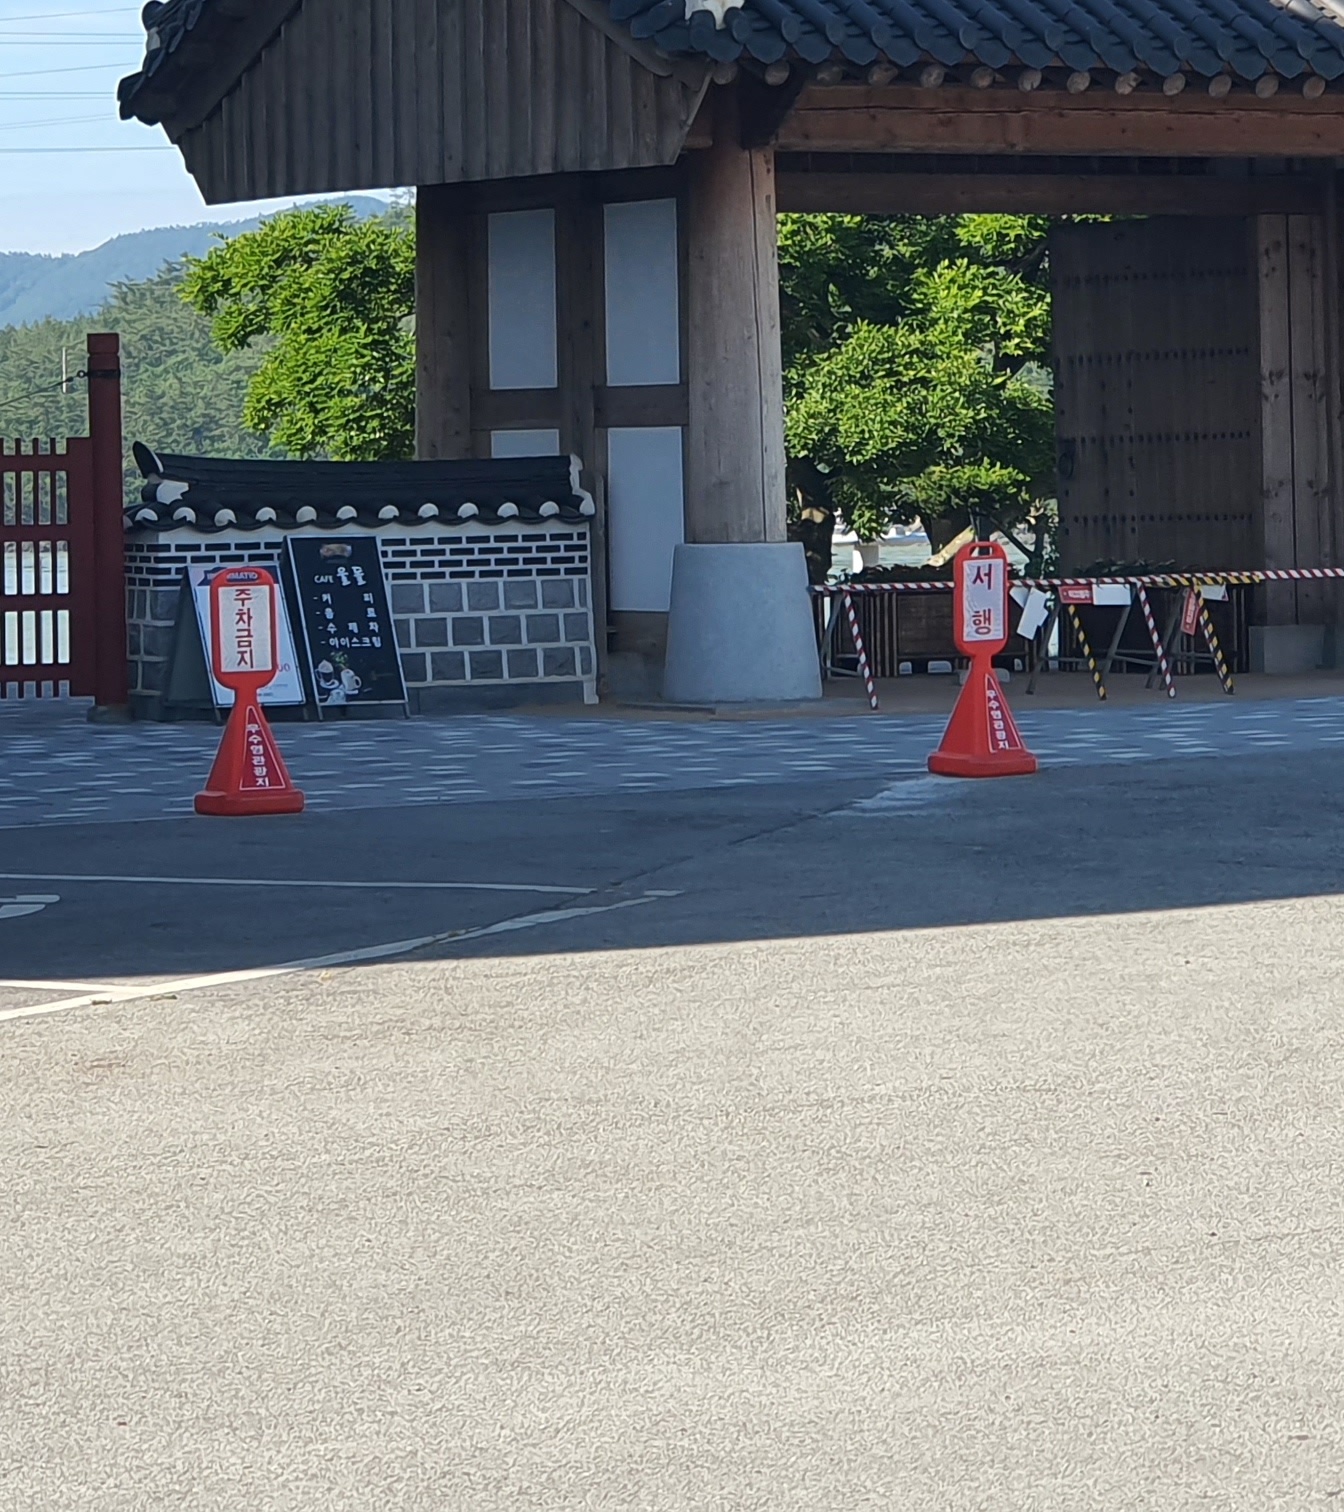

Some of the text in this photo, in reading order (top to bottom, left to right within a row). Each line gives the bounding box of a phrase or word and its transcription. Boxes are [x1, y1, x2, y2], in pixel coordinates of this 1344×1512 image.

[314, 575, 334, 584] CAFE
[233, 588, 254, 669] 주차금지
[986, 689, 1009, 750] 우수영관광지
[246, 723, 269, 787] 우수영관광지
